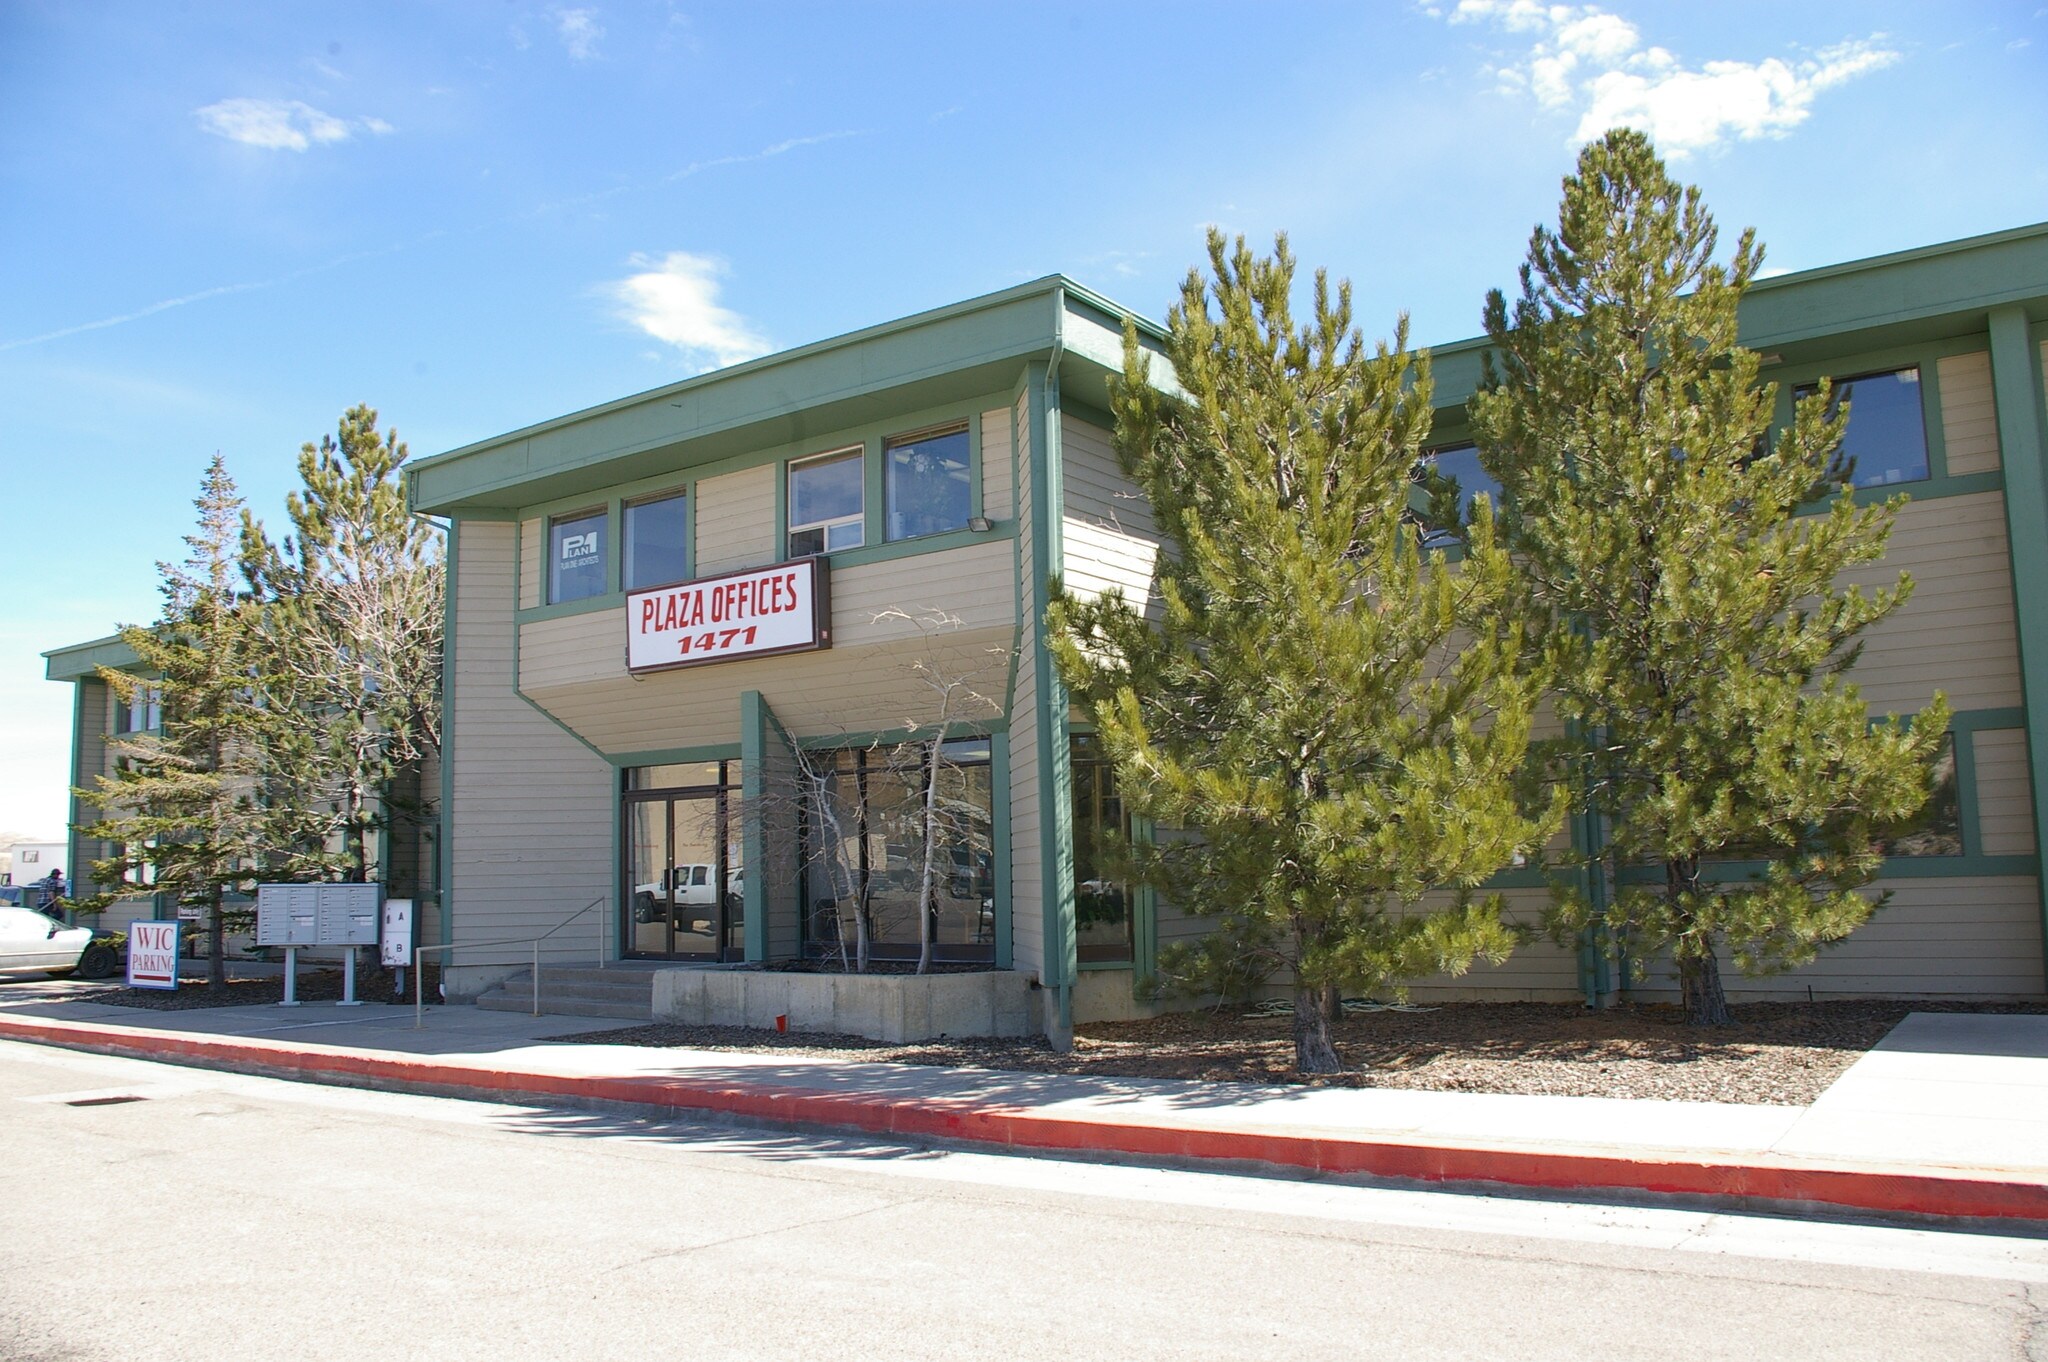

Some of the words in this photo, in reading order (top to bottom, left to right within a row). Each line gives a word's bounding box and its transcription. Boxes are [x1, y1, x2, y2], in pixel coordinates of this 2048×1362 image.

[641, 589, 705, 634] PLAZA
[711, 573, 797, 622] OFFICES
[677, 625, 757, 654] 1471
[398, 911, 405, 921] A
[136, 926, 174, 951] WIC
[396, 943, 403, 953] B
[131, 953, 175, 973] PARKING
